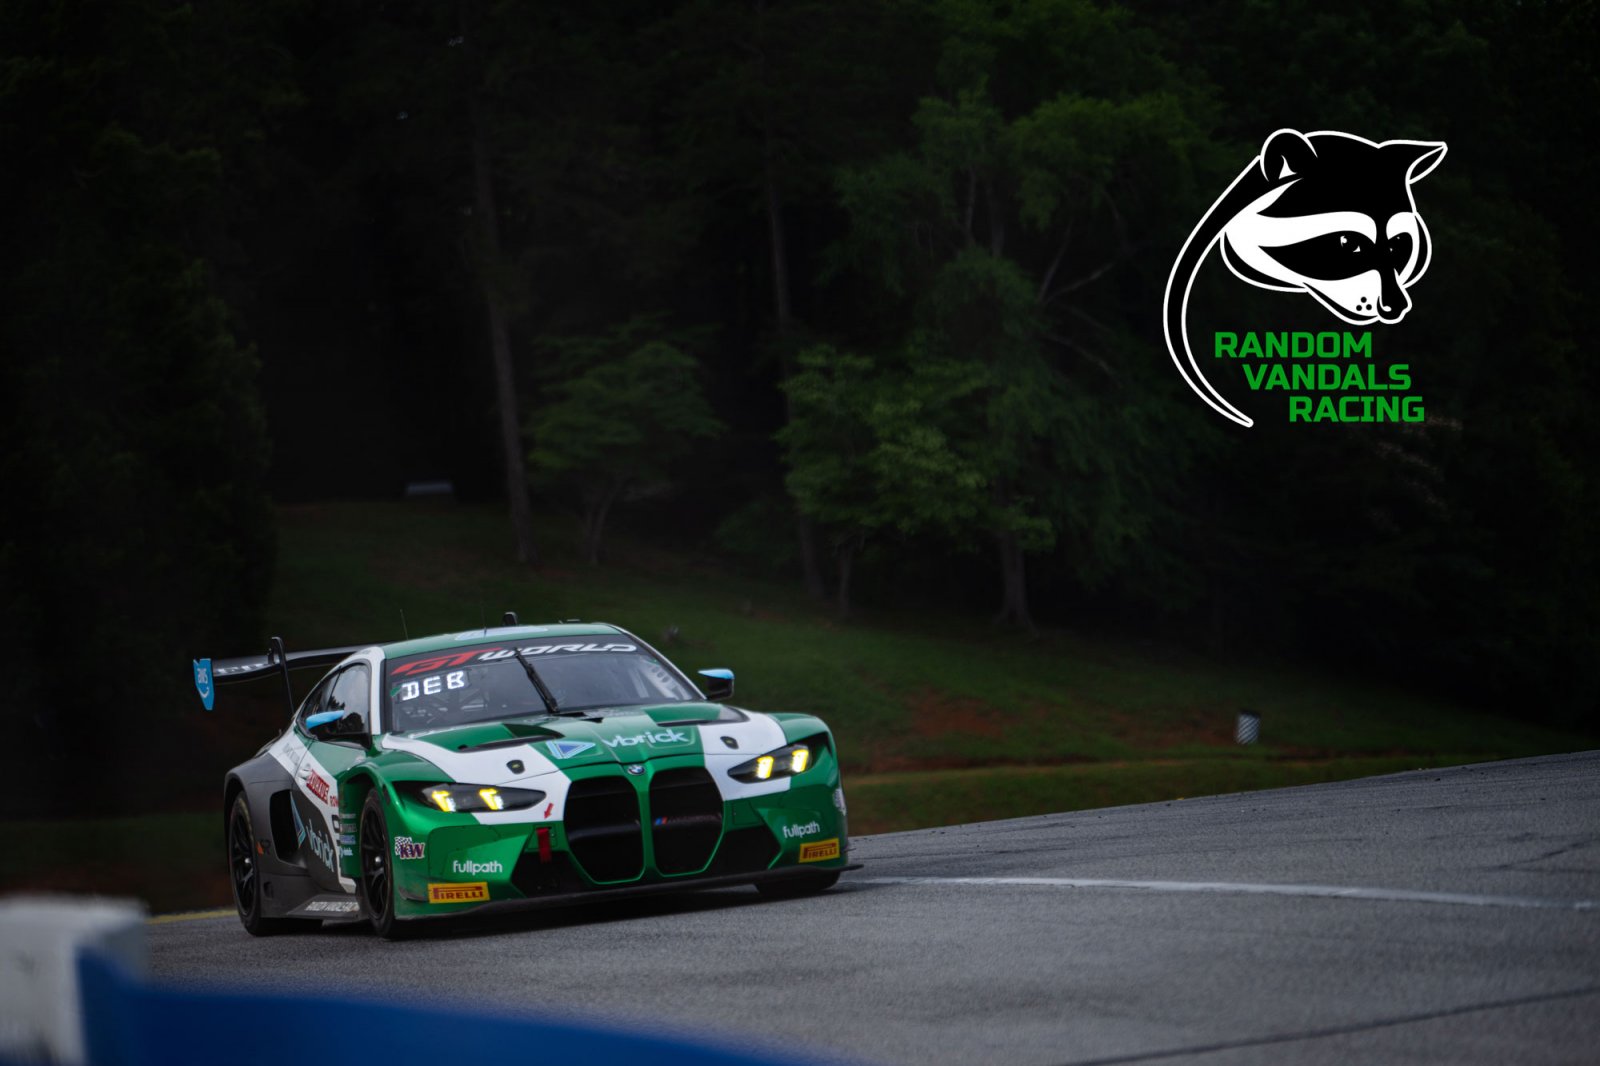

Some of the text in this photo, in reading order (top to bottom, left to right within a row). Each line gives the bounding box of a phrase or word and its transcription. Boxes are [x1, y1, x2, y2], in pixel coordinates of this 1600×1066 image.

[477, 643, 638, 661] WORLD
[601, 728, 690, 748] vbrick
[782, 820, 821, 839] fullpath
[400, 842, 425, 860] KW
[803, 842, 837, 859] PIRELLI
[453, 860, 503, 875] fullpath
[432, 886, 484, 900] PIRELLI
